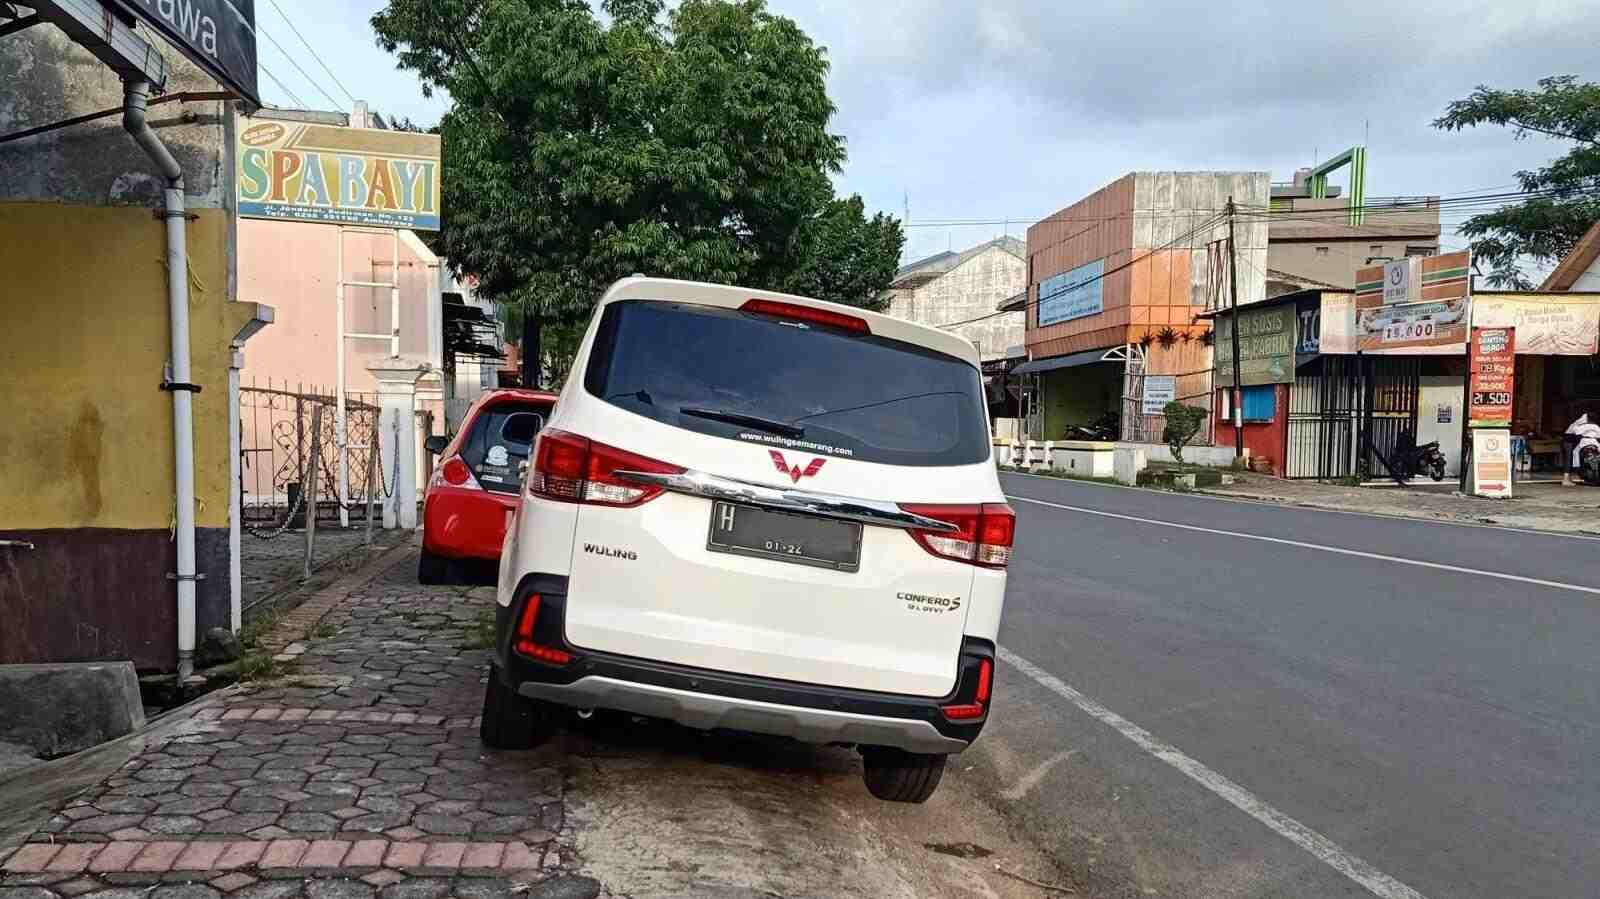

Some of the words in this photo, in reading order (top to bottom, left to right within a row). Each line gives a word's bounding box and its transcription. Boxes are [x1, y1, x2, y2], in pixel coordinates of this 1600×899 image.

[239, 148, 330, 207] SPA
[336, 153, 436, 214] BAYI
[740, 432, 853, 457] www.wulingsemarang.com
[720, 504, 736, 532] H
[583, 543, 638, 561] WULING
[896, 592, 951, 607] CONFERO
[947, 597, 962, 611] S
